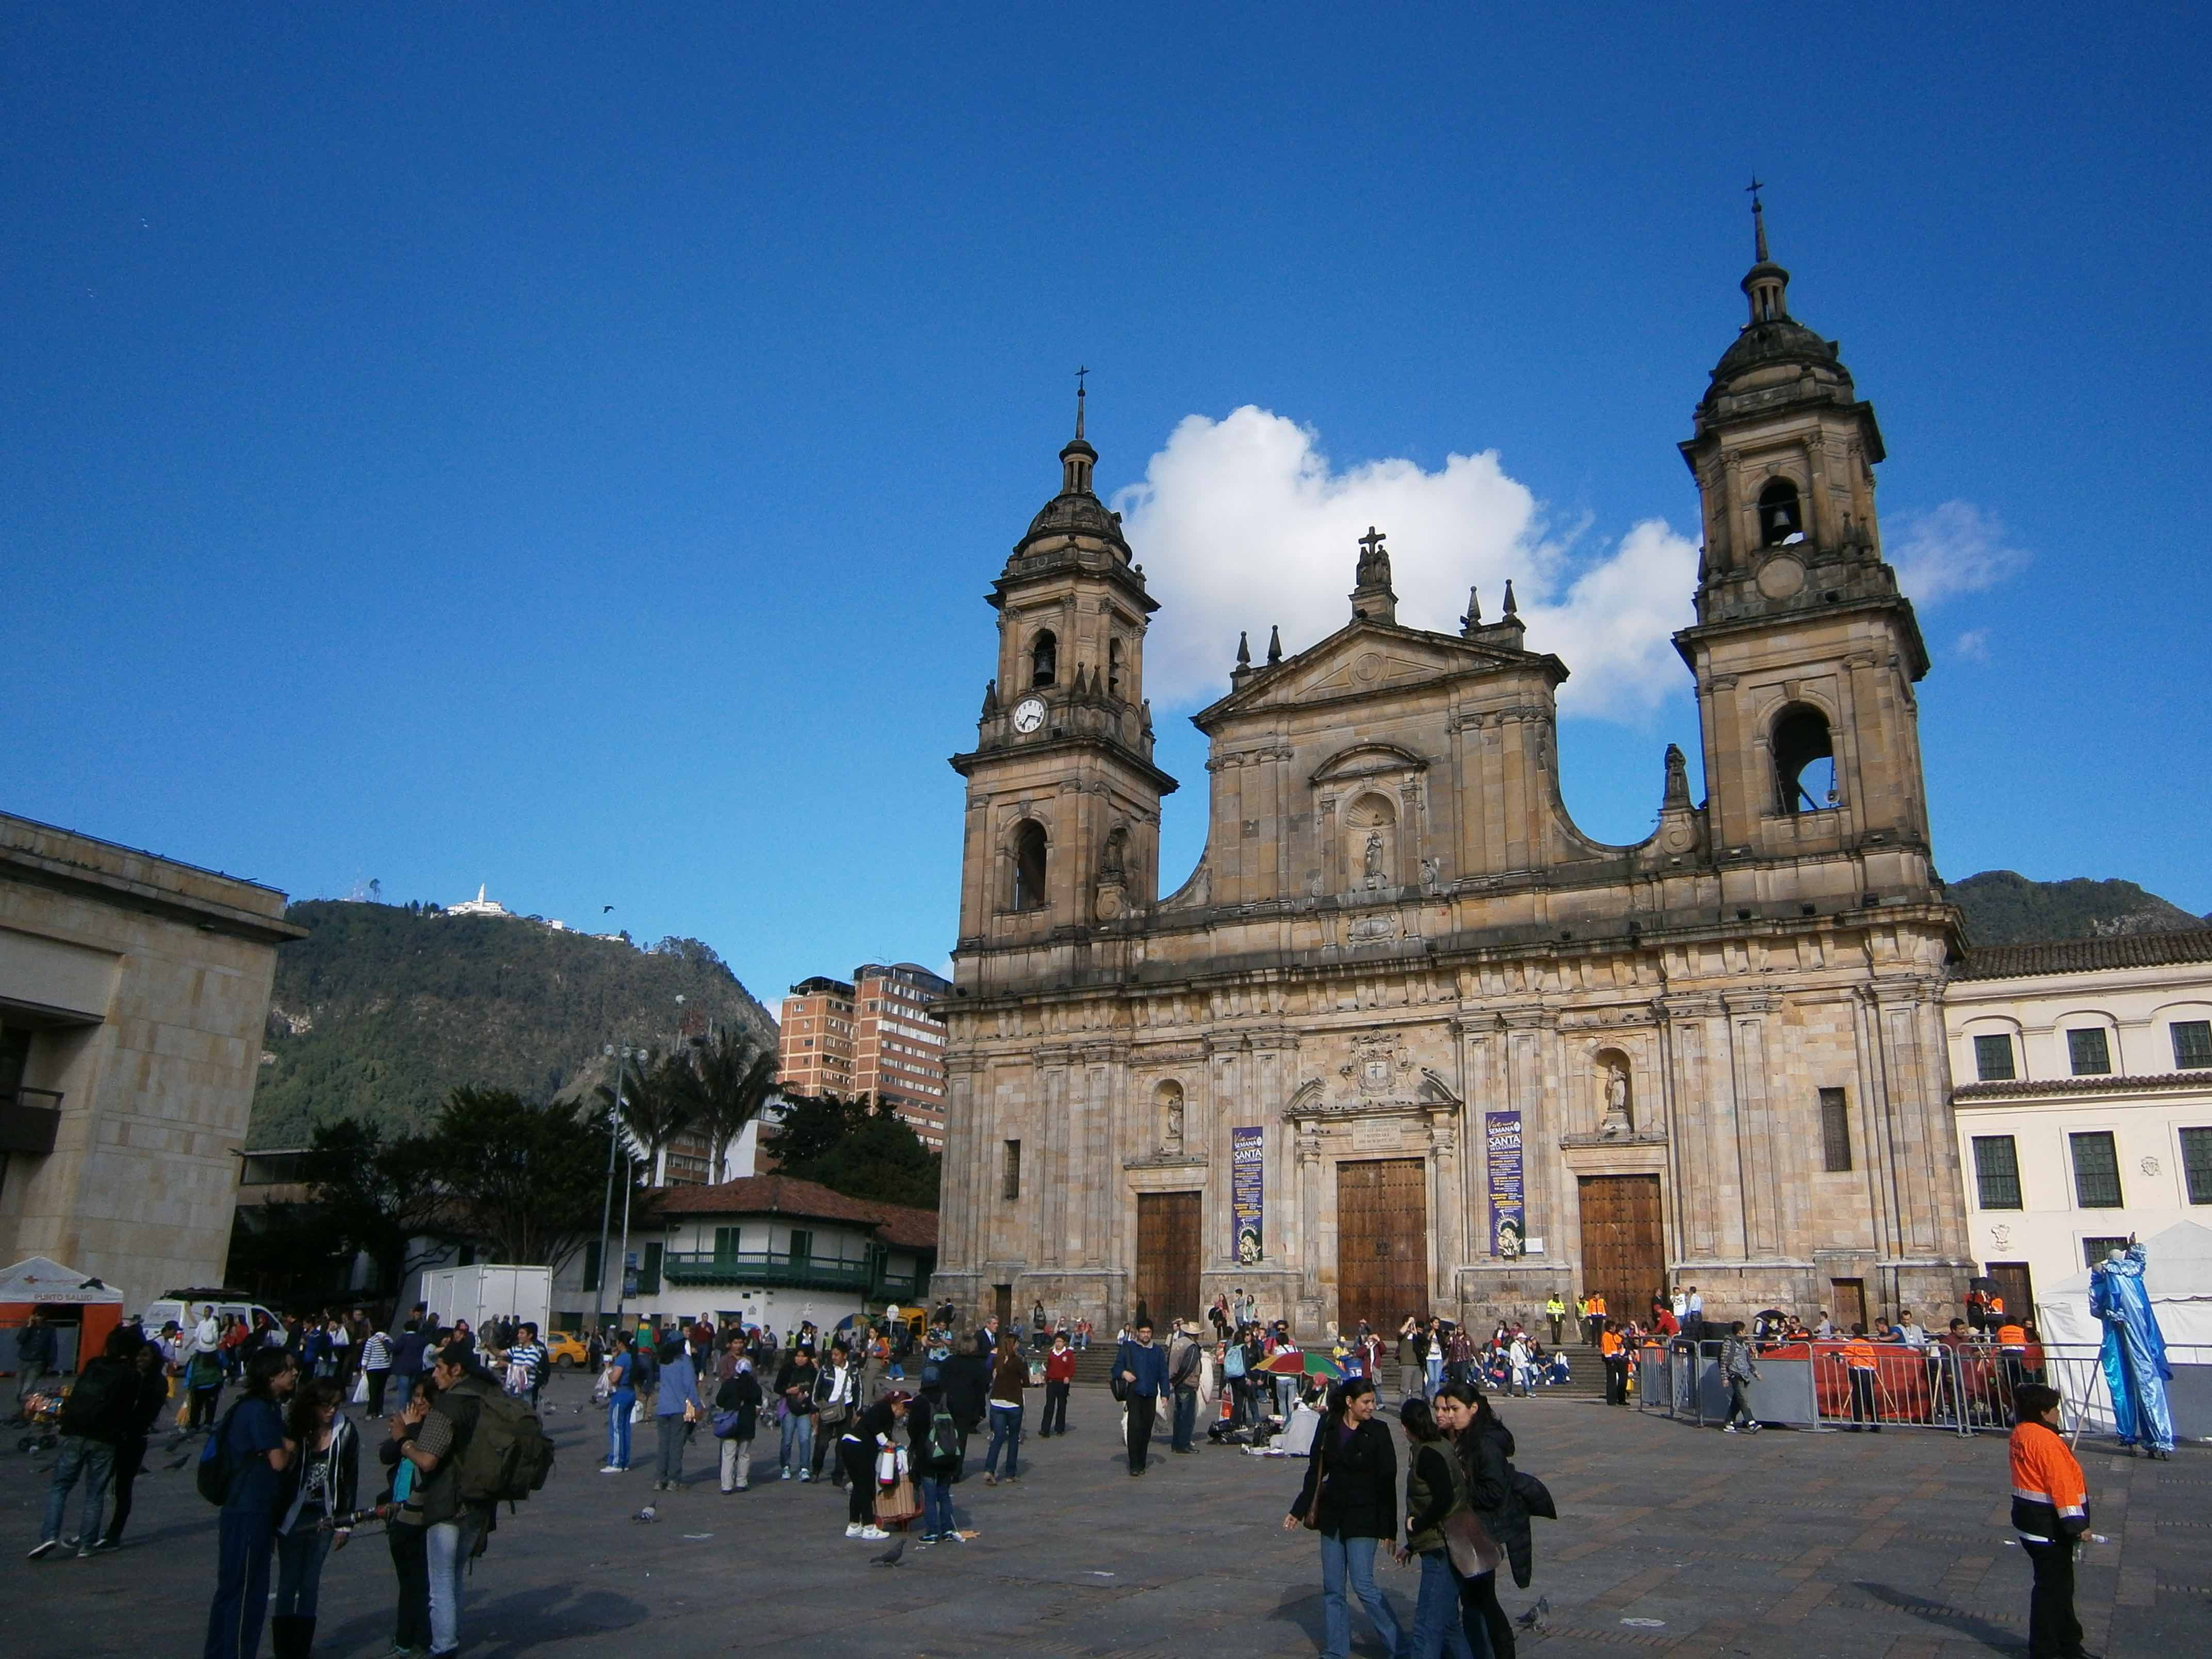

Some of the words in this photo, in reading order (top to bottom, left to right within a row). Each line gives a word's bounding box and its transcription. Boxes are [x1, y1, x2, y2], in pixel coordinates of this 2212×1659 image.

[1489, 1126, 1514, 1134] SEMANA
[1234, 1140, 1257, 1148] SEMANA
[1489, 1135, 1521, 1147] SANTA
[1234, 1149, 1262, 1160] SANTA
